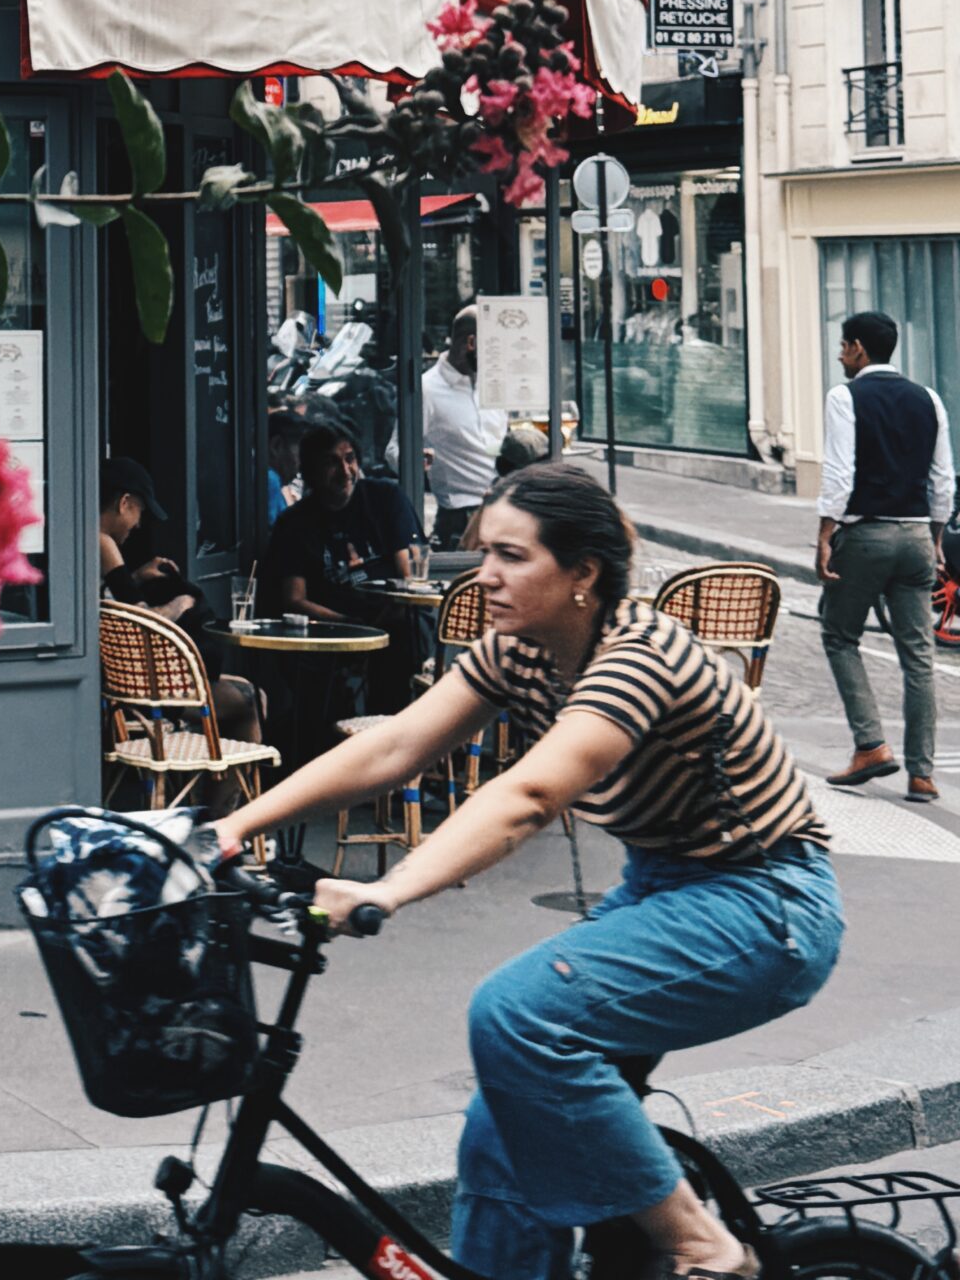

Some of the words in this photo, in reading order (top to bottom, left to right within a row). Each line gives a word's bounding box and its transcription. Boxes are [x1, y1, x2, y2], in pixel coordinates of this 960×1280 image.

[659, 11, 729, 26] RETOUCHE
[655, 31, 669, 43] 01
[703, 32, 717, 45] 21
